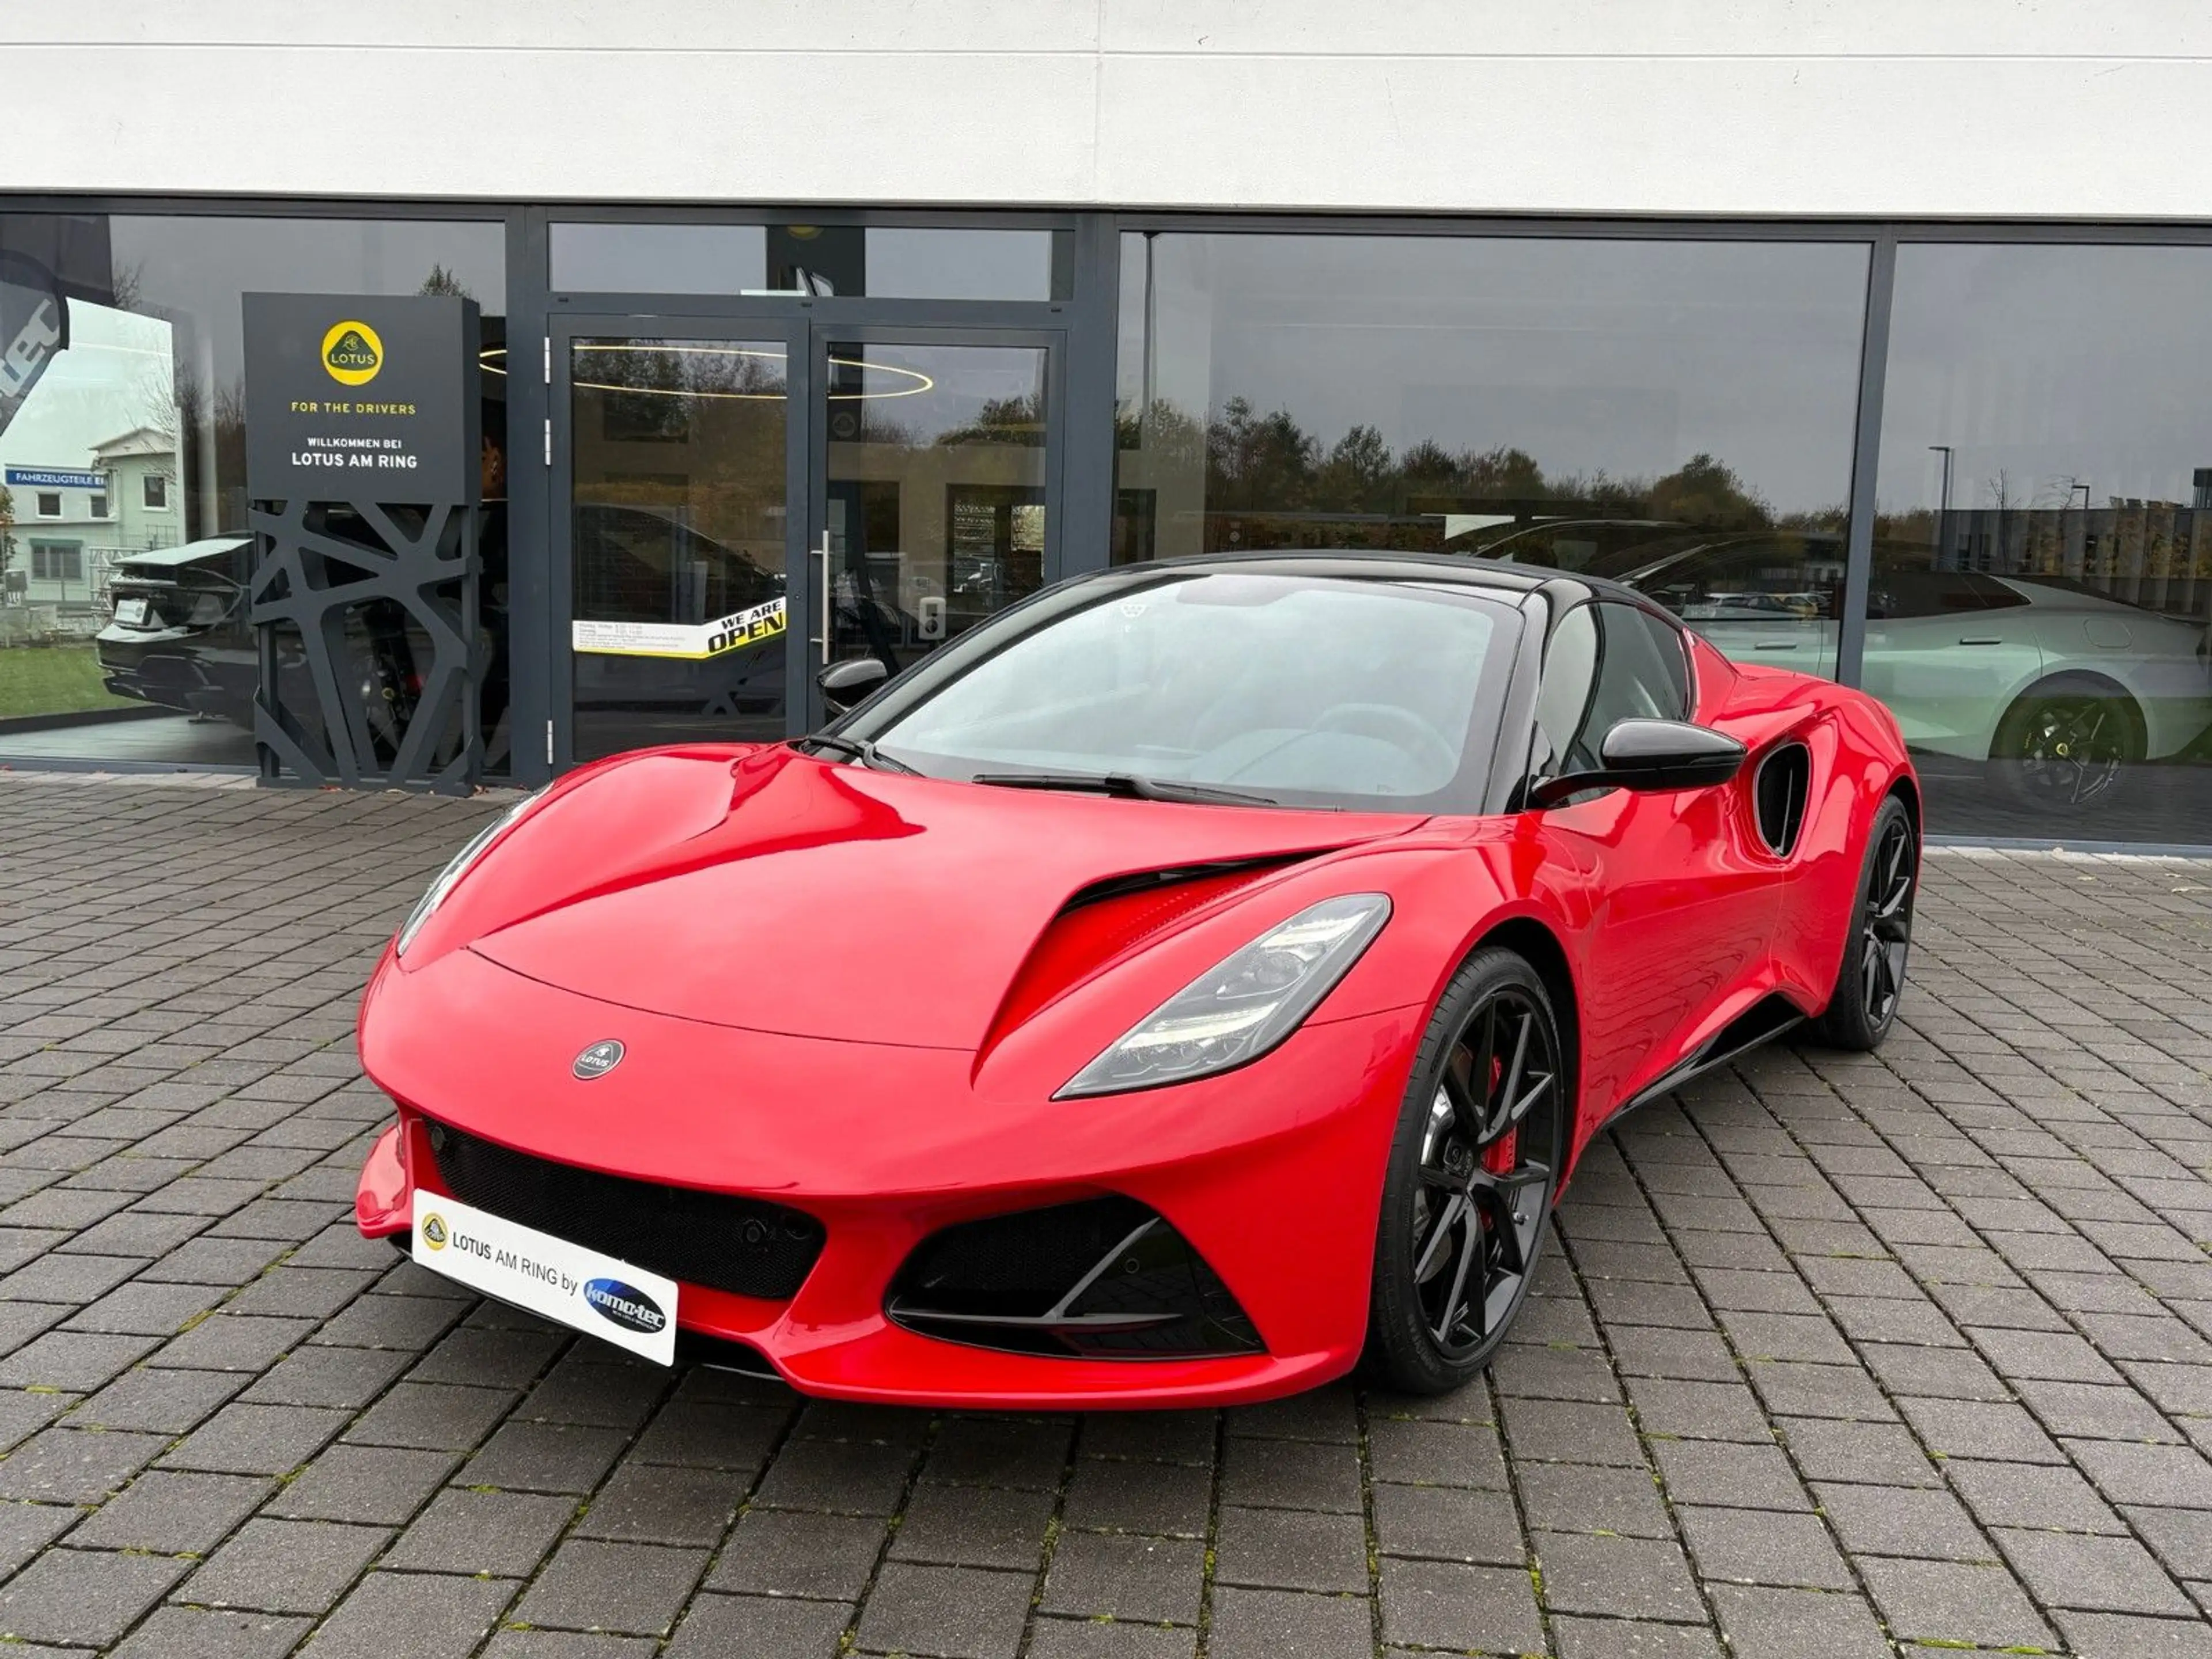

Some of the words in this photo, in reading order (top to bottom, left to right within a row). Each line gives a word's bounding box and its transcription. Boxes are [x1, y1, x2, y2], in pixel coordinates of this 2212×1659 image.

[331, 353, 375, 365] LOTUS
[291, 402, 318, 412] FOR
[324, 403, 350, 414] THE
[356, 403, 416, 415] DRIVERS
[308, 437, 380, 449] WILLKOMMEN
[383, 440, 402, 449] BEI
[291, 452, 344, 467] LOTUS
[349, 454, 373, 467] AM
[378, 455, 417, 468] RING
[16, 472, 93, 484] FAHRZEUGTEILE
[721, 614, 745, 629] WE
[751, 601, 782, 620] ARE
[708, 612, 783, 653] OPEN
[453, 1232, 491, 1259] LOTUS
[495, 1249, 517, 1270] AM
[521, 1258, 557, 1285] RING
[562, 1273, 578, 1296] by
